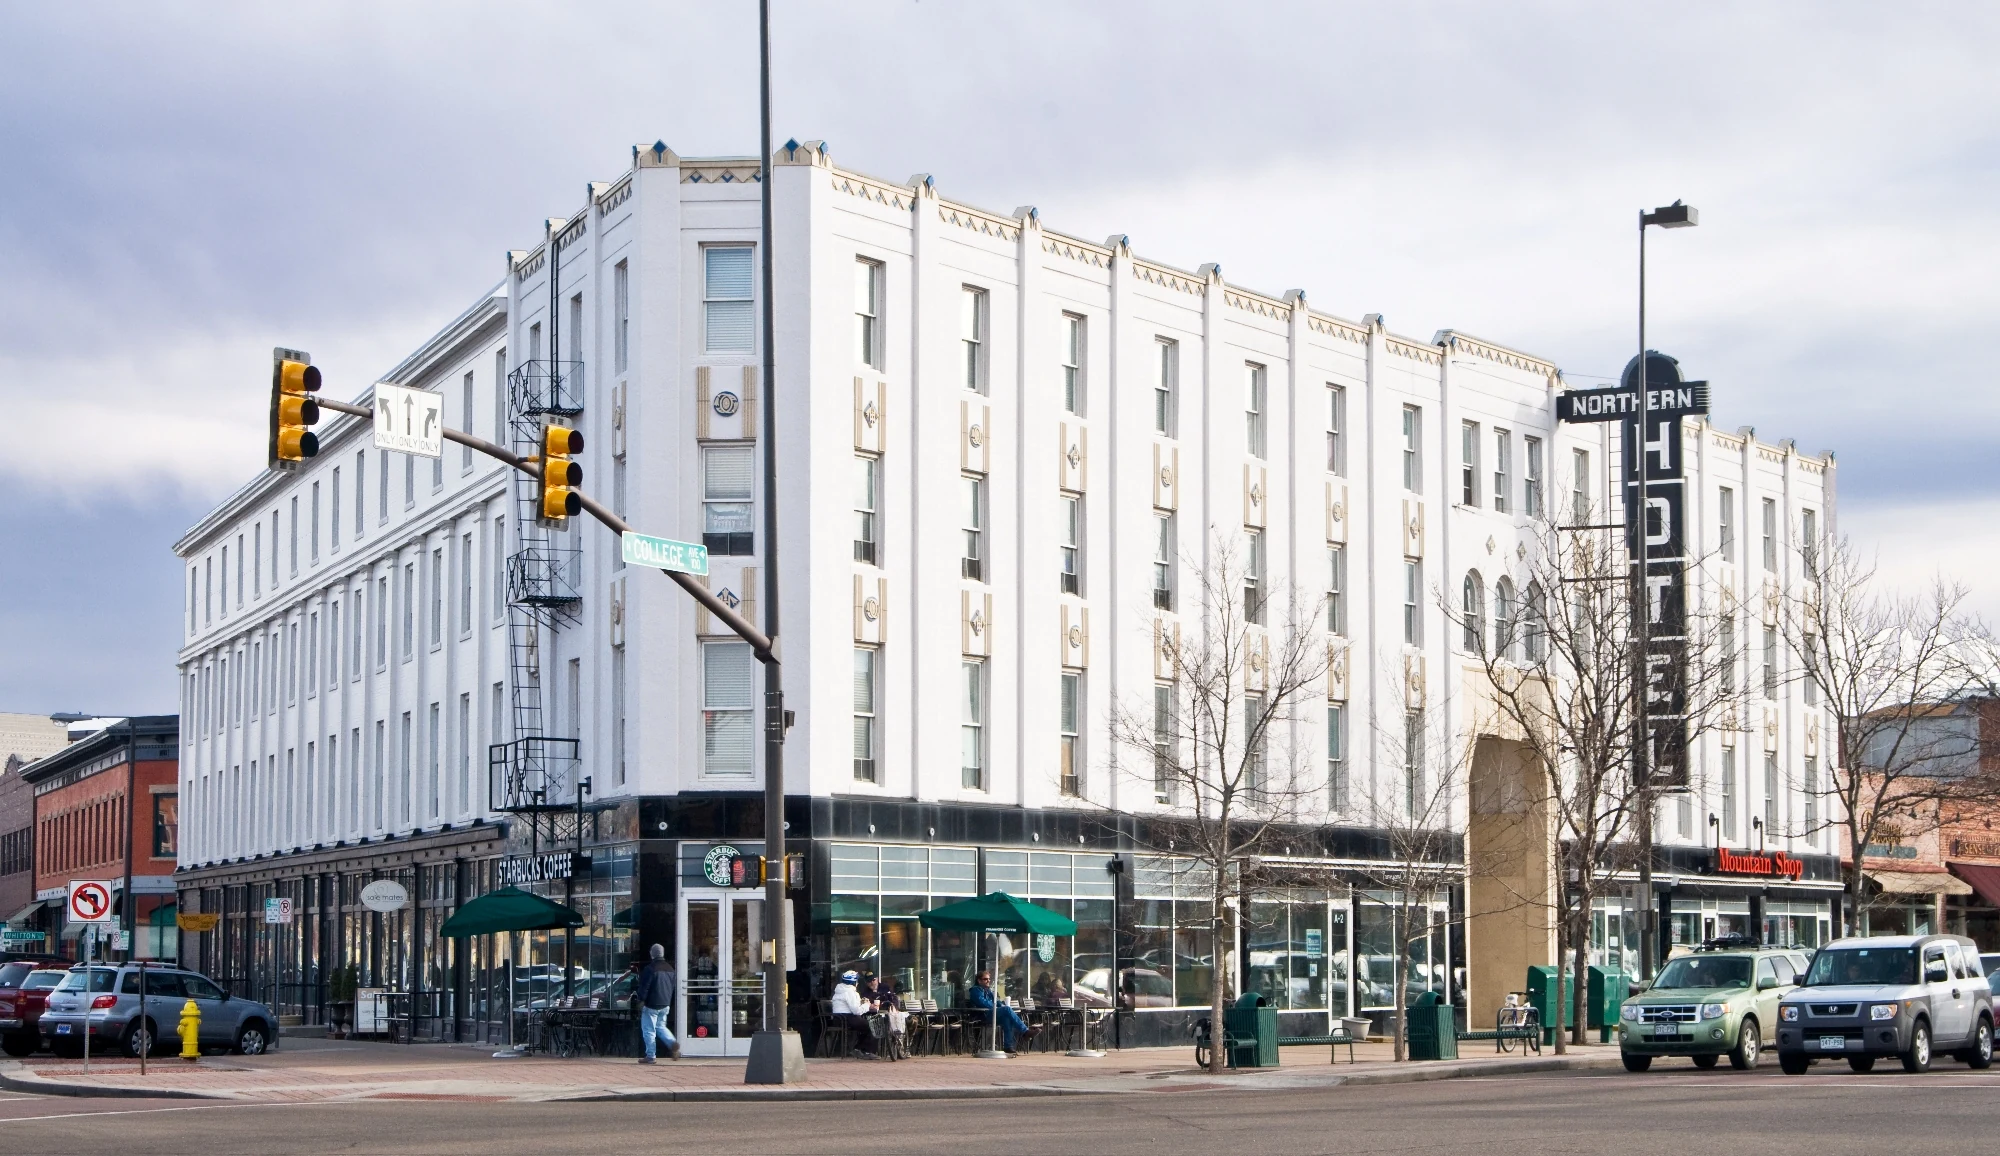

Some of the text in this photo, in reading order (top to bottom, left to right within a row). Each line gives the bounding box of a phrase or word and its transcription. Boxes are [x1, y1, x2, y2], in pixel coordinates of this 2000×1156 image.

[1572, 388, 1692, 416] NORTHERN
[376, 432, 395, 445] ONLY
[399, 436, 417, 448] ONLY
[420, 440, 438, 452] ONLY
[633, 538, 685, 567] COLLEGE
[688, 547, 699, 559] AVE
[691, 559, 701, 570] 100
[1634, 421, 1674, 777] HOTEL
[705, 847, 738, 865] STARBUC
[498, 852, 572, 884] STARBUCKS COFFEE
[1718, 847, 1803, 882] Mountain Shop
[709, 872, 731, 884] COFF
[1333, 914, 1344, 924] A-2
[5, 932, 36, 940] WHITTON
